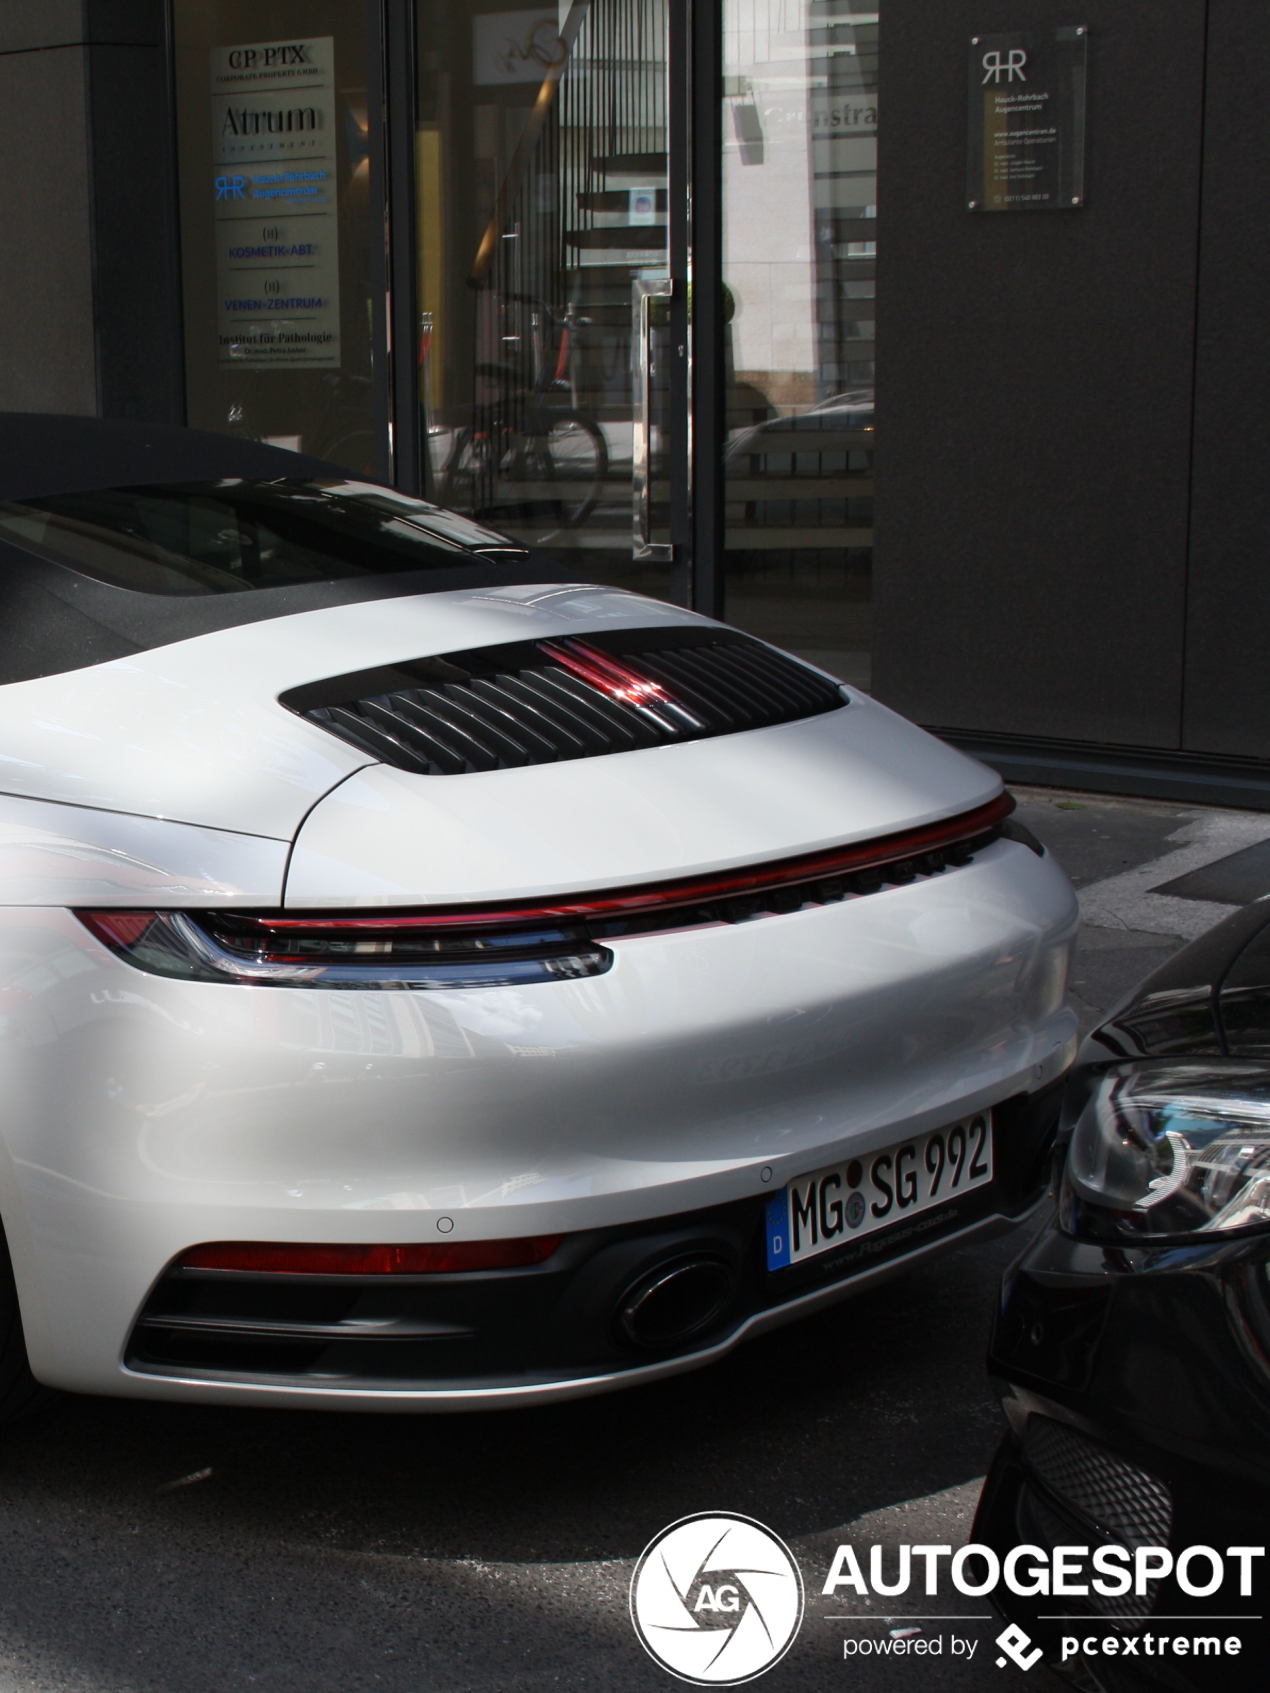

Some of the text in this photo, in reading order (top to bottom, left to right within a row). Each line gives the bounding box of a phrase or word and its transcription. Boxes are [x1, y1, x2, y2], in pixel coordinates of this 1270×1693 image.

[229, 44, 306, 70] CP PTX
[994, 92, 1049, 104] Hauck-Rohrbach
[994, 103, 1042, 114] Augencentrum
[221, 106, 316, 138] Atrum
[253, 185, 318, 200] Augencentrum
[219, 331, 332, 345] Institut für Pathologie
[790, 1115, 988, 1253] MG SG 992
[773, 1236, 783, 1255] D
